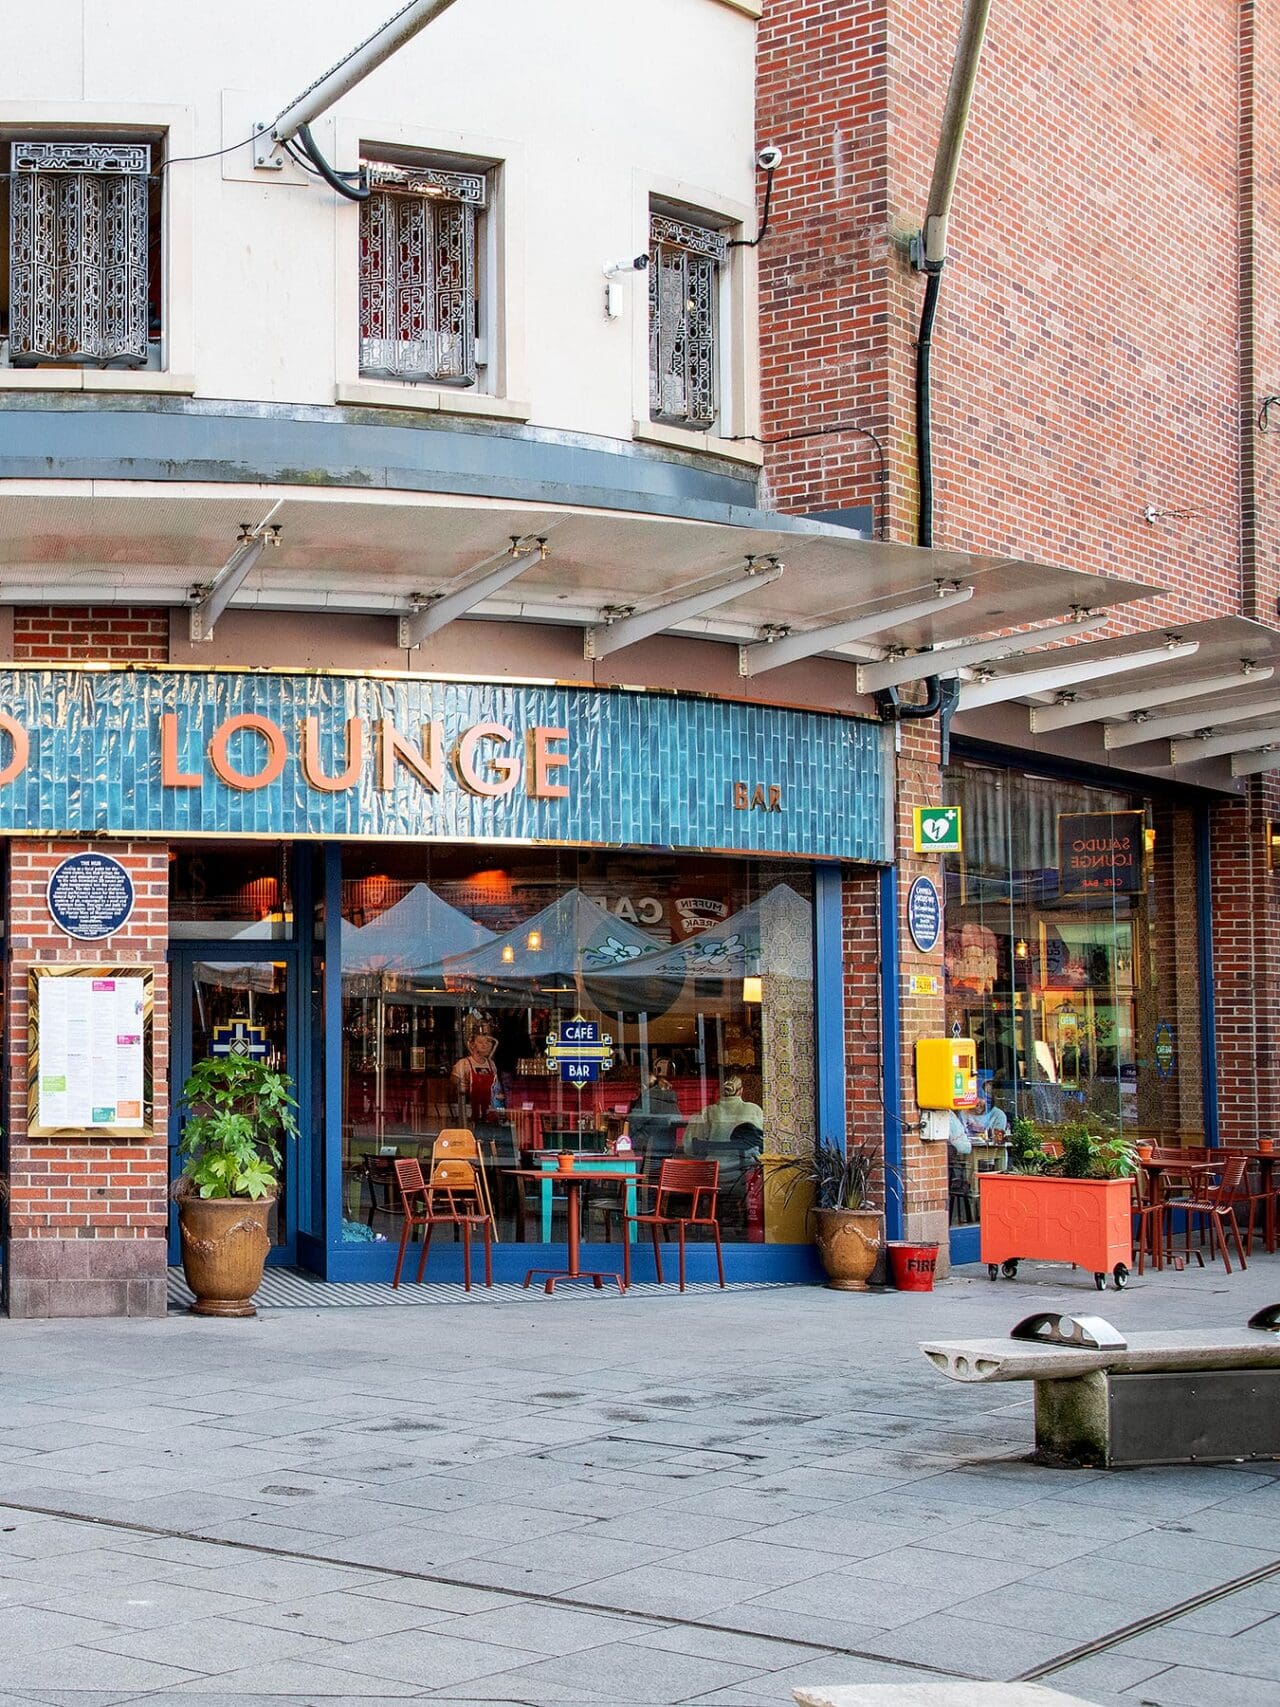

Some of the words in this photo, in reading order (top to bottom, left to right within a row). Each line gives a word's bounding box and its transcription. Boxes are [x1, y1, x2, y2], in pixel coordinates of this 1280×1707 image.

[161, 713, 569, 798] LOUNGE
[733, 782, 782, 813] BAR
[565, 1025, 593, 1039] CAFÉ
[569, 1065, 590, 1077] BAR
[907, 1259, 936, 1272] FIRE
